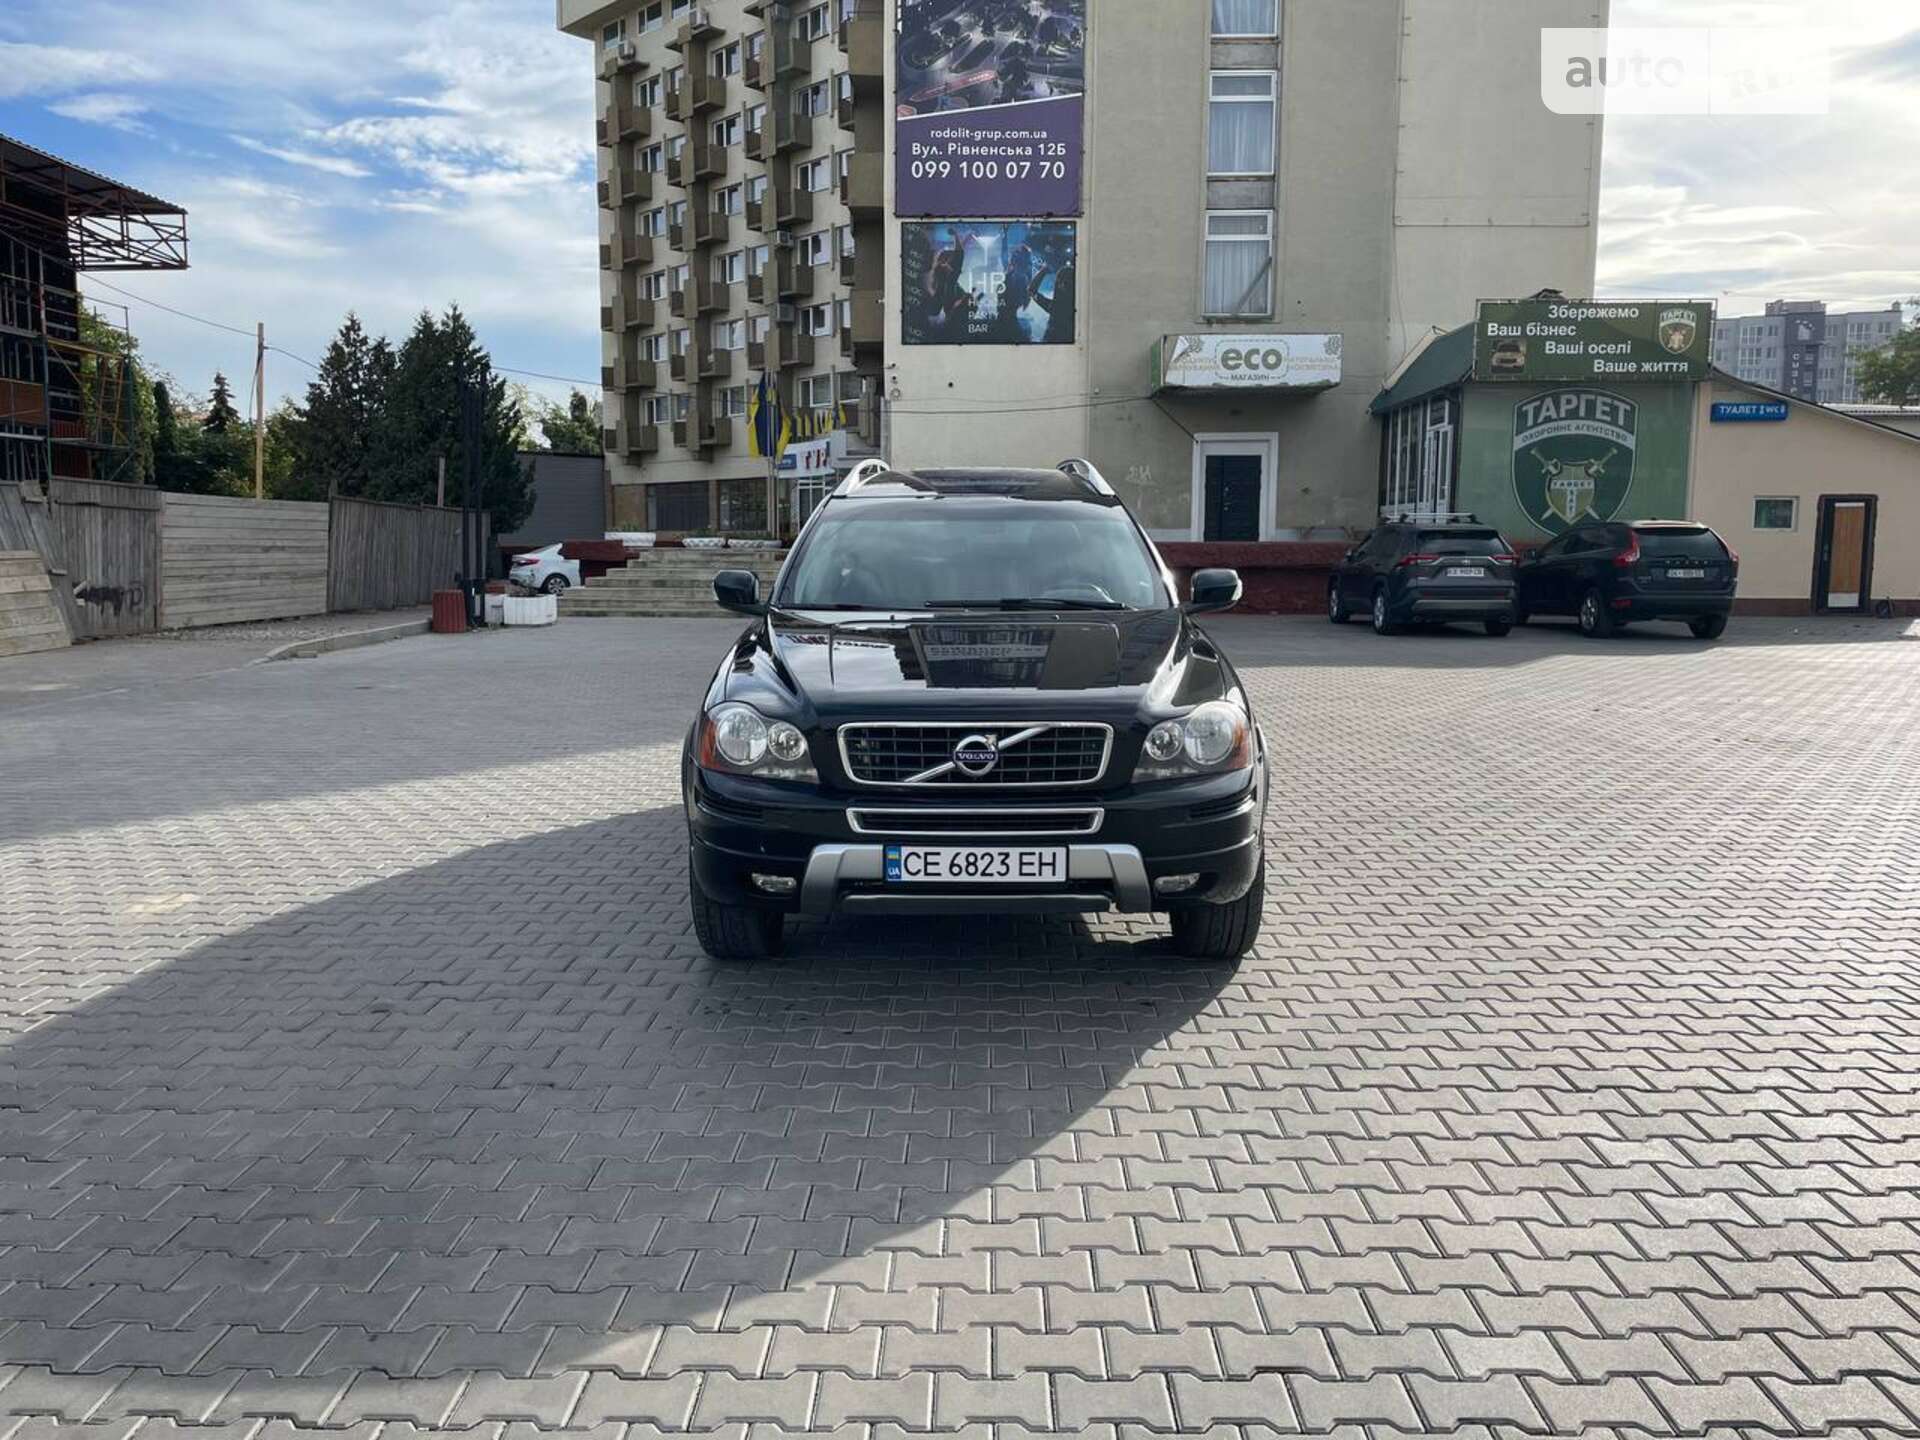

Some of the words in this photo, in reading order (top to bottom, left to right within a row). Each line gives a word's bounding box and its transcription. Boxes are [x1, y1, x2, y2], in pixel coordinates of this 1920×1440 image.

[930, 127, 1048, 141] rodolit-grup.com.ua
[911, 142, 943, 158] Вул.
[947, 142, 1033, 156] Рівненська
[1037, 143, 1067, 156] 12Б
[911, 161, 951, 179] 099
[959, 161, 998, 179] 100
[1005, 161, 1031, 179] 07
[1039, 161, 1066, 179] 70
[1547, 304, 1640, 322] Збережемо
[968, 323, 989, 334] BAR
[1487, 322, 1522, 337] Ваш
[1526, 321, 1577, 337] бізнес
[1544, 340, 1585, 354] Ваші
[1588, 340, 1632, 354] оселі
[1220, 348, 1283, 371] eco
[1593, 359, 1637, 373] Ваше
[1641, 361, 1689, 373] життя
[1522, 393, 1632, 428] ТАРГЕТ
[1719, 404, 1758, 415] ТУАЛЕТ
[1521, 424, 1572, 443] ОХОРОННЕ
[1574, 423, 1629, 442] АГЕНТСТВО
[957, 752, 995, 761] VOLVO
[887, 866, 900, 877] UA
[903, 851, 942, 877] CE
[948, 851, 1011, 877] 6823
[1018, 851, 1057, 877] EH
